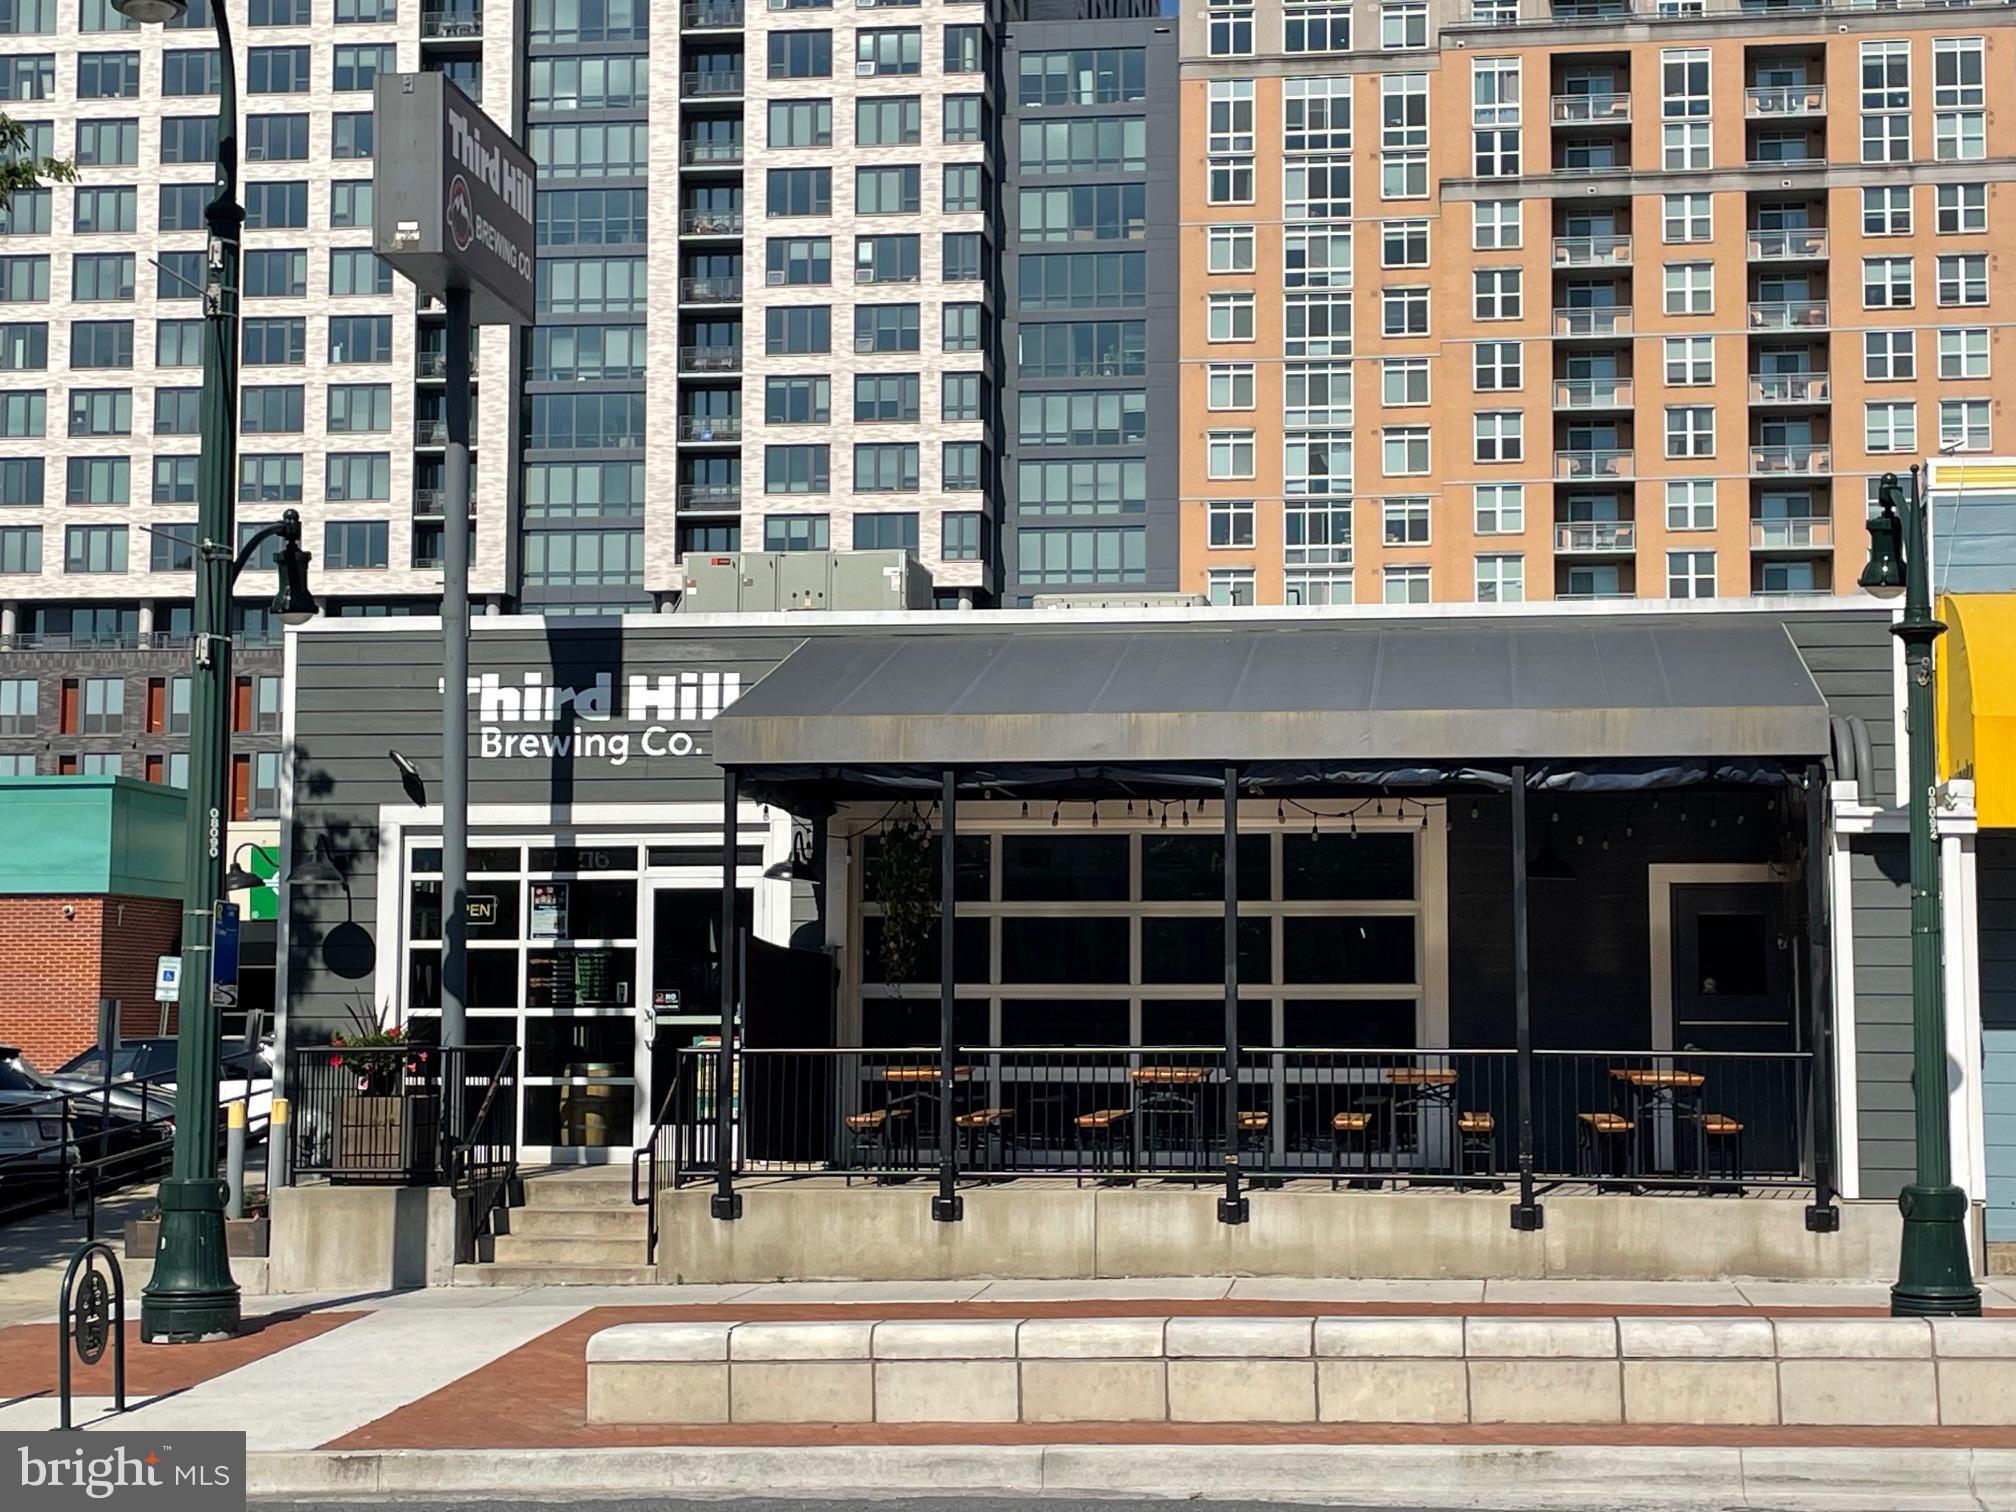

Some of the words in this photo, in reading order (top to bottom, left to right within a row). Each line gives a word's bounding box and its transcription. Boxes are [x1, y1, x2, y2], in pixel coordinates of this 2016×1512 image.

[449, 108, 501, 196] Third
[503, 158, 533, 225] Hill
[476, 214, 517, 269] BREWING
[518, 251, 533, 282] CO.
[628, 672, 741, 721] Hill
[480, 726, 630, 766] Brewing
[641, 725, 703, 756] Co.
[466, 903, 491, 917] EN
